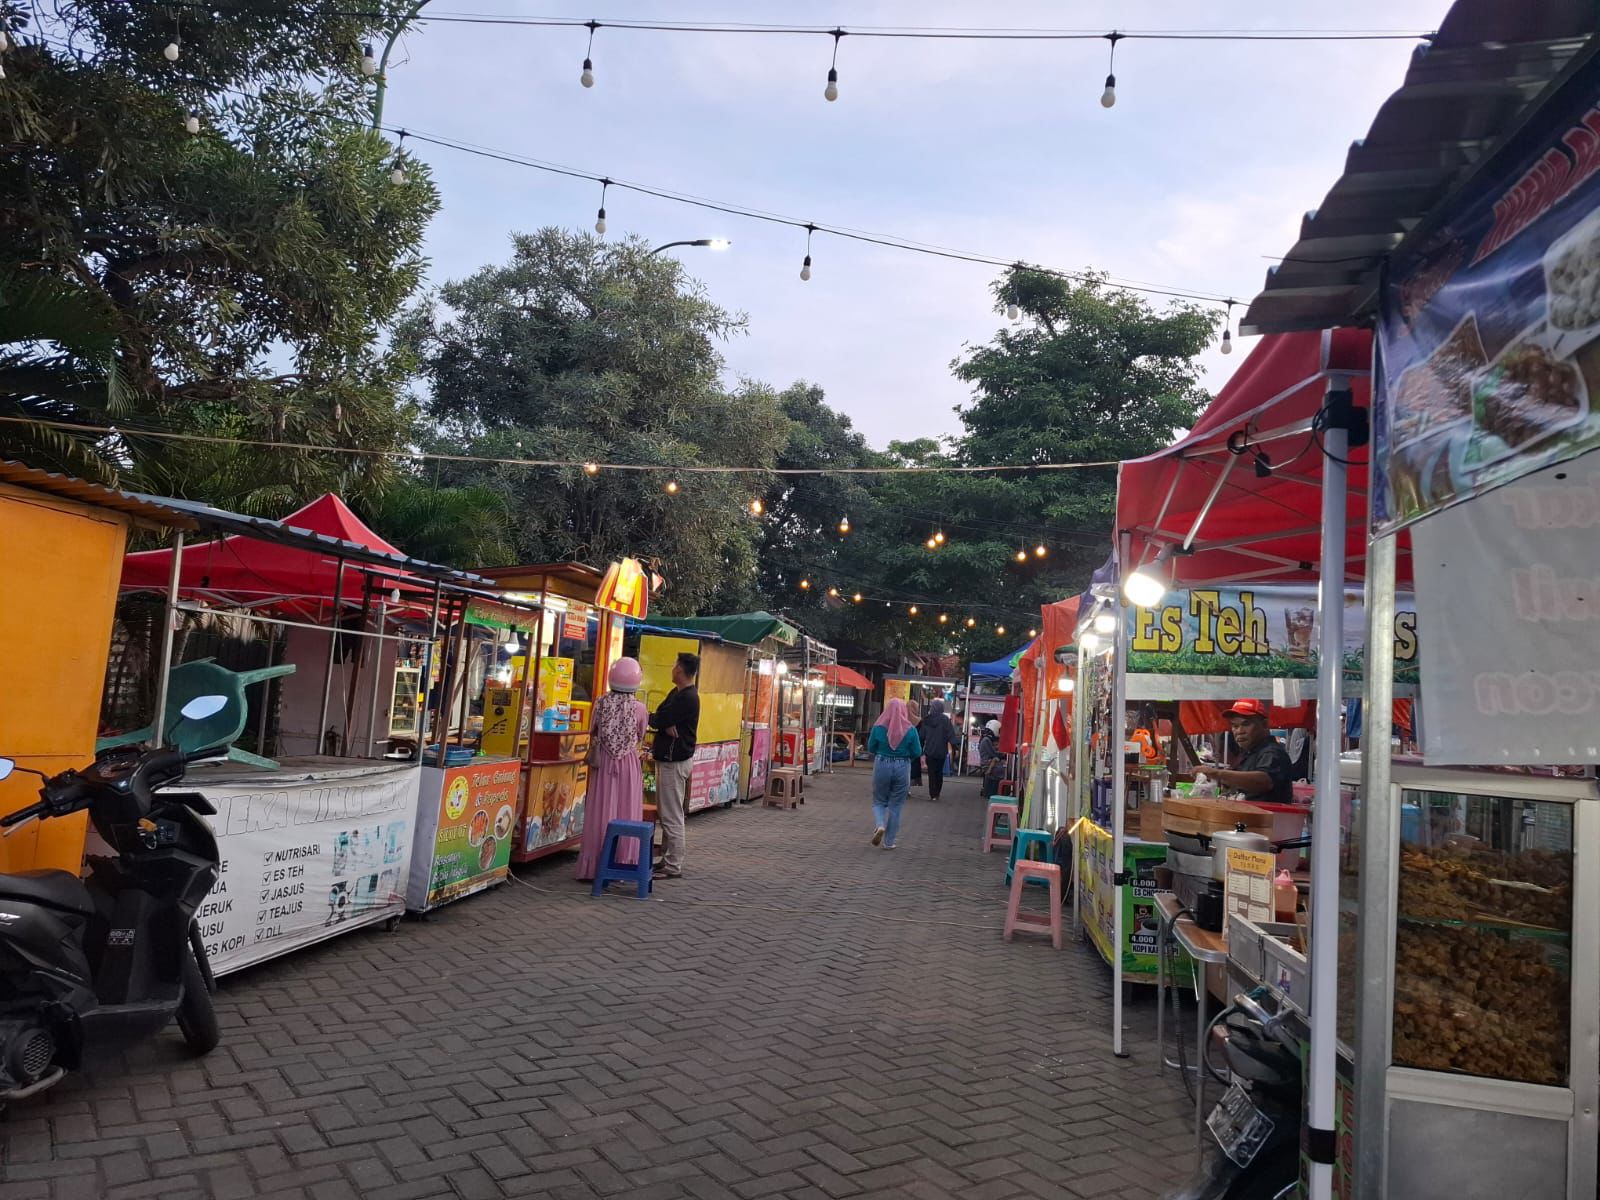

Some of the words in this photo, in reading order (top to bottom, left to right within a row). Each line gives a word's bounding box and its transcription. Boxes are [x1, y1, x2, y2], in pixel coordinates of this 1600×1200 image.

[1131, 604, 1183, 653] Es
[1189, 590, 1270, 655] Teh
[208, 791, 289, 837] NEKA
[274, 843, 320, 864] NUTRISARI
[273, 868, 285, 882] ES
[287, 864, 304, 877] TEH
[271, 882, 305, 901] JASJUS
[196, 899, 233, 919] JERUK
[269, 901, 303, 920] TEAJUS
[266, 925, 283, 939] DLL
[221, 935, 245, 953] KOPI
